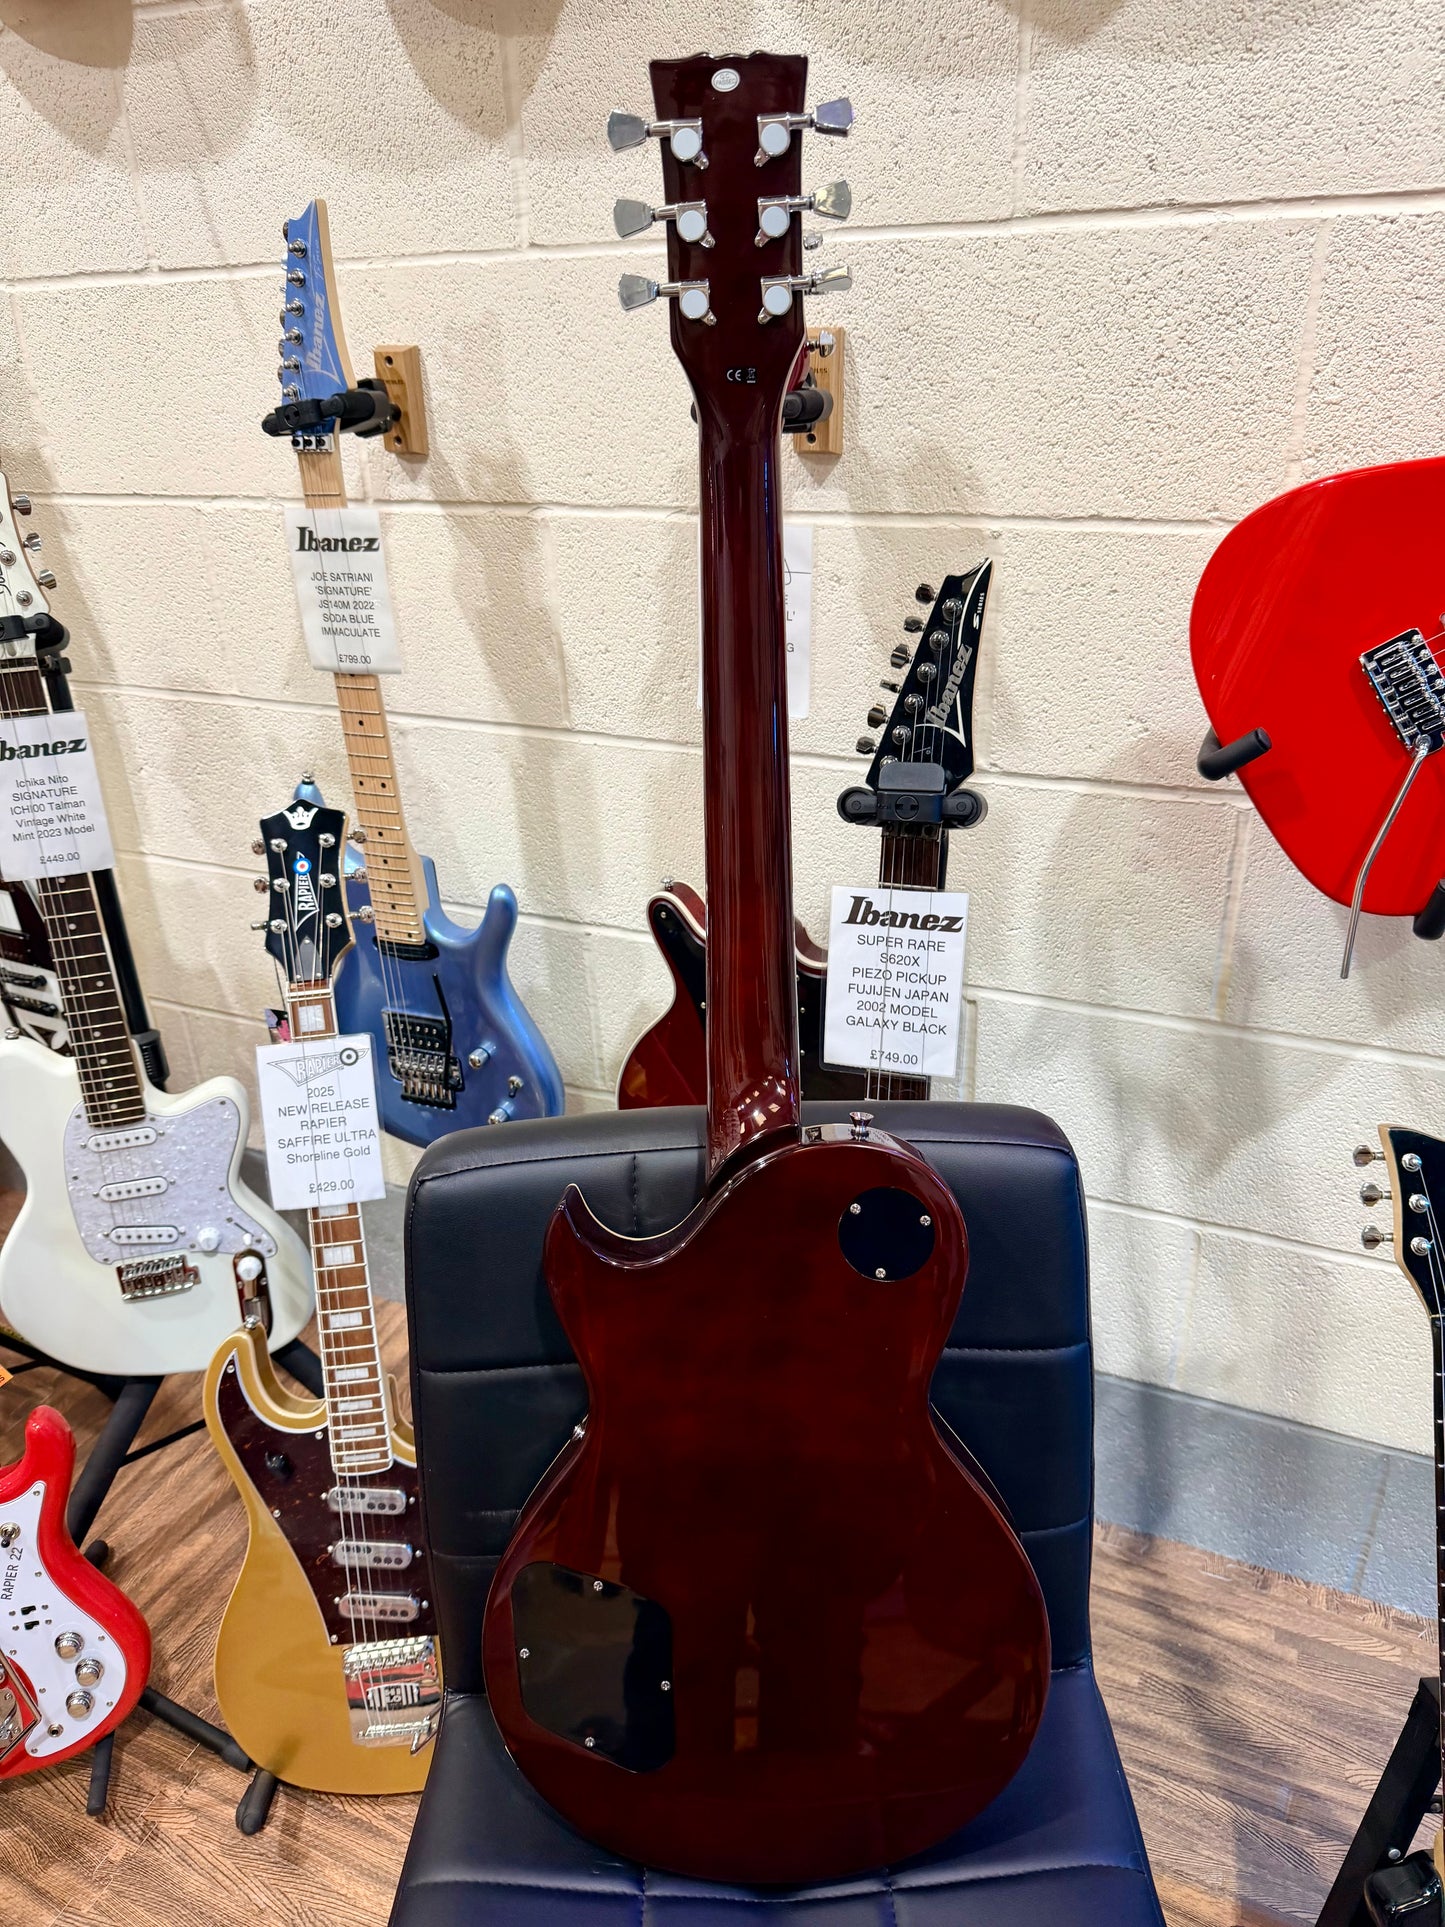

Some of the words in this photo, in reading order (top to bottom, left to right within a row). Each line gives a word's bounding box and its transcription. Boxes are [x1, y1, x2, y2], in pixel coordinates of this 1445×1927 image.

[306, 292, 326, 371] Ibanez
[727, 369, 742, 381] CE
[295, 526, 380, 552] Ibanez
[310, 572, 329, 582] JOE
[330, 572, 374, 583] SATRIANI
[315, 586, 373, 597] 'SIGNATURE'
[318, 600, 350, 610] JS140M
[353, 600, 375, 610] 2022
[322, 613, 348, 623] SODA
[350, 614, 375, 625] BLUE
[321, 626, 381, 638] IMMACULATE
[338, 654, 372, 665] £799.00
[925, 643, 973, 733] Ibanez
[0, 737, 87, 761] banez
[15, 777, 46, 788] Ichika
[47, 774, 69, 786] Nito
[12, 786, 78, 801] SIGNATURE
[48, 799, 86, 811] Talman
[15, 815, 55, 828] Vintage
[56, 812, 86, 823] White
[12, 830, 35, 842] Mint
[37, 828, 62, 839] 2023
[64, 823, 95, 836] Model
[39, 851, 80, 865] £449.00
[297, 873, 316, 911] RAPIER
[841, 895, 964, 933] Ibanez
[857, 934, 904, 950] SUPER
[907, 938, 946, 952] RARE
[879, 953, 920, 967] S620X
[852, 967, 893, 981] PIEZO
[896, 972, 947, 985] PICKUP
[848, 983, 901, 998] FUJIJEN
[904, 989, 949, 1003] JAPAN
[856, 1000, 886, 1013] 2002
[890, 1004, 938, 1019] MODEL
[846, 1015, 899, 1030] GALAXY
[902, 1021, 947, 1035] BLACK
[869, 1050, 918, 1065] £749.00
[296, 1055, 341, 1082] RAPIER
[307, 1085, 335, 1099] 2025
[277, 1104, 308, 1118] NEW
[311, 1098, 370, 1114] RELEASE
[300, 1116, 347, 1131] RAPIER
[277, 1134, 331, 1149] SAFFIRE
[334, 1128, 377, 1143] ULTRA
[286, 1149, 341, 1164] Shoreline
[343, 1145, 371, 1158] Gold
[308, 1179, 355, 1194] £429.00
[1, 1564, 19, 1600] RAPIER
[10, 1547, 23, 1561] 22
